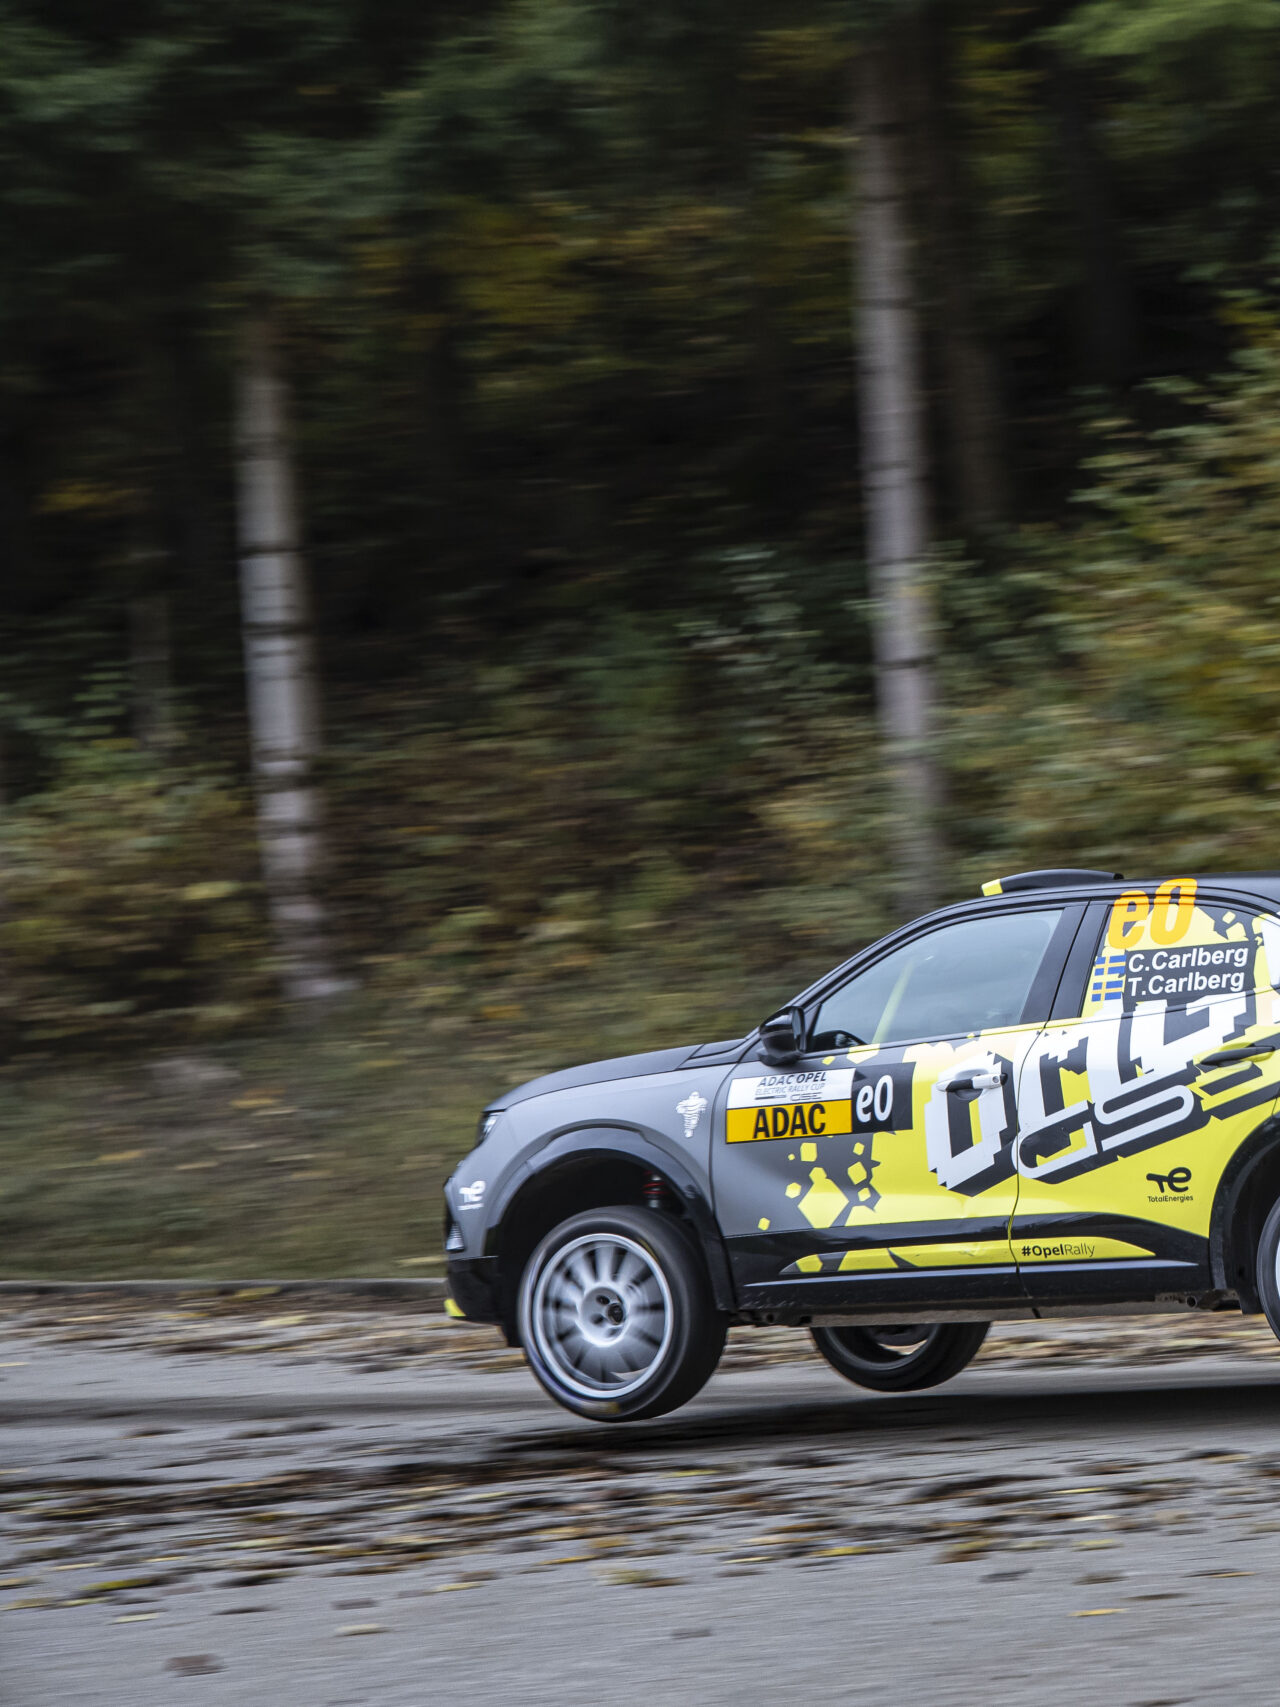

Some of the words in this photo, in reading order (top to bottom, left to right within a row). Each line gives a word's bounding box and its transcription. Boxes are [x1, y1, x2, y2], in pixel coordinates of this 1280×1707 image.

[1108, 878, 1198, 949] e0
[1128, 948, 1249, 973] C.Carlberg
[1127, 971, 1245, 997] T.Carlberg
[758, 1075, 795, 1087] ADAC
[796, 1071, 827, 1084] OPEL
[856, 1075, 893, 1123] e0
[753, 1103, 826, 1139] ADAC
[1147, 1194, 1194, 1203] TotalEnergies
[1021, 1243, 1096, 1258] #OpelRally
